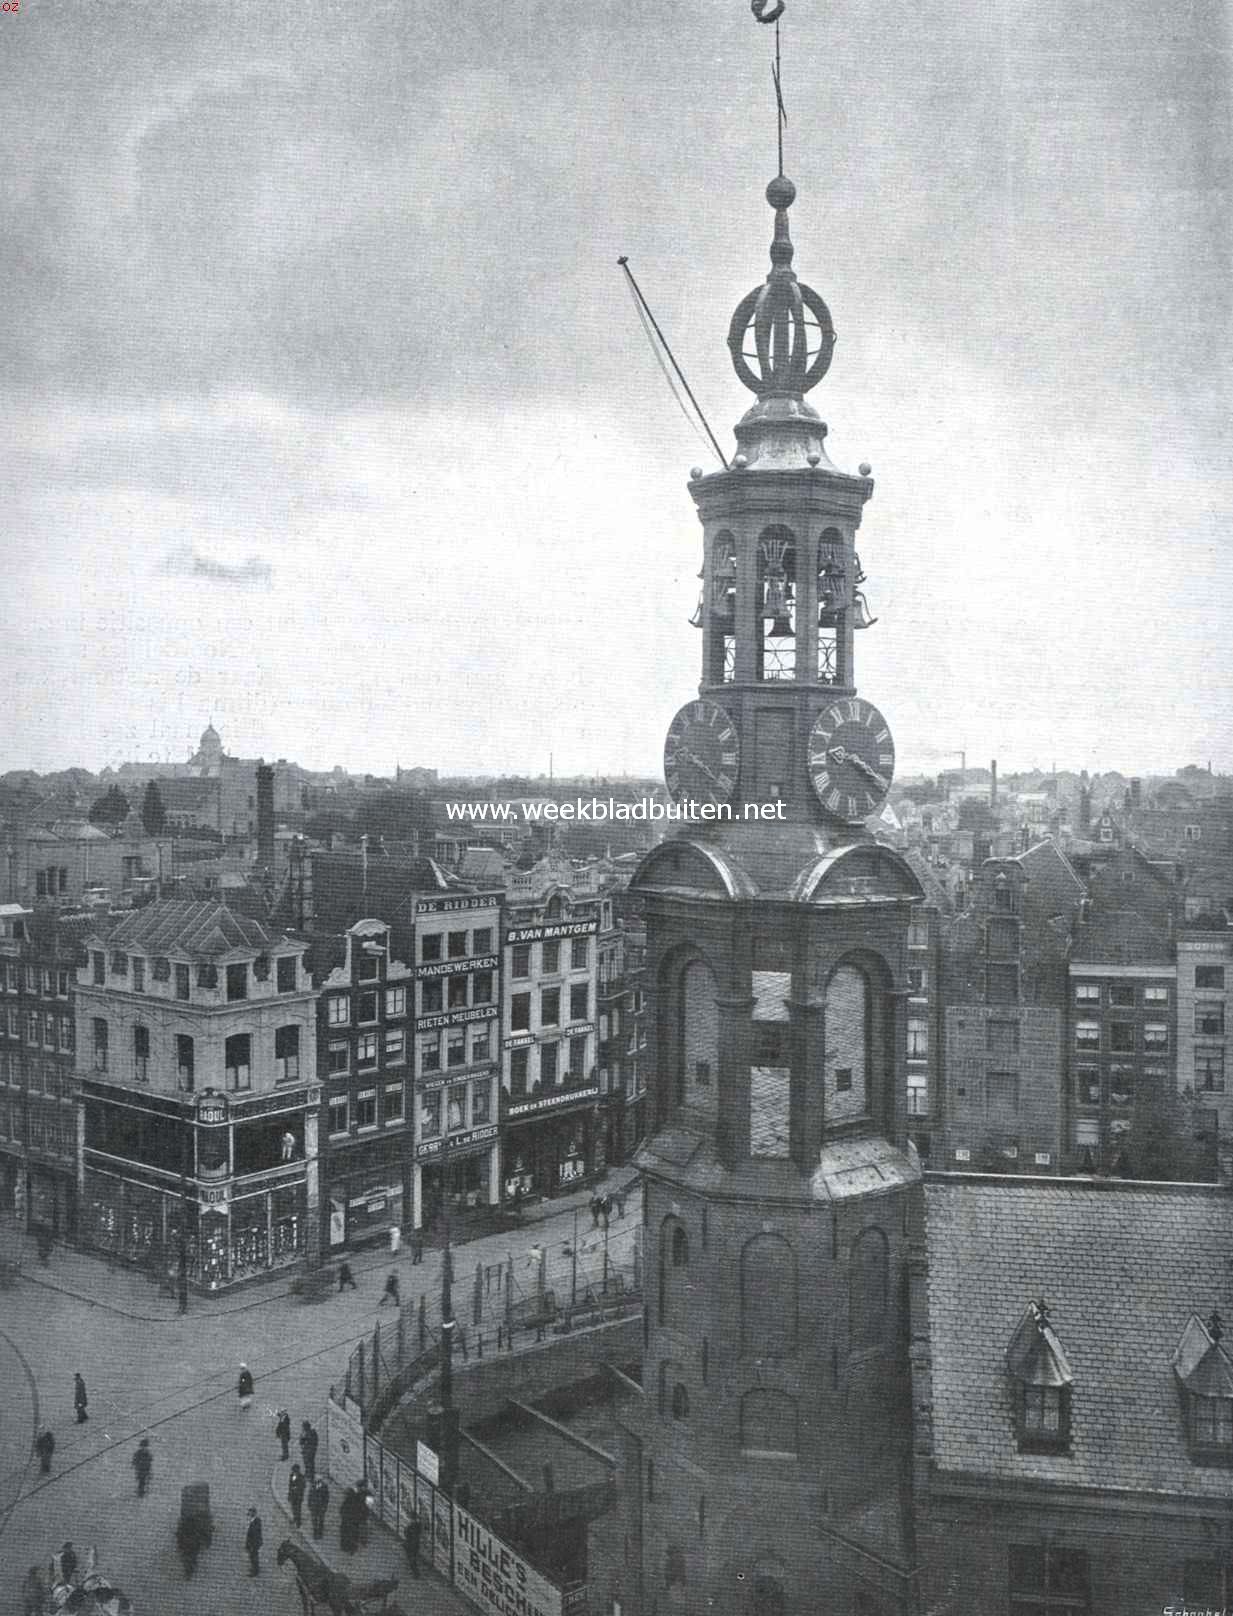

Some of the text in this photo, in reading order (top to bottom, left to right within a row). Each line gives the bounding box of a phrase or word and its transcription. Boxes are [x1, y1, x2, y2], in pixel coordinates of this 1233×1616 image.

[418, 897, 497, 913] DE RIDDER
[544, 922, 597, 938] MANTGEM
[417, 957, 498, 978] MANDEWERKEN
[417, 1007, 498, 1030] RIETEN MEUBELEN
